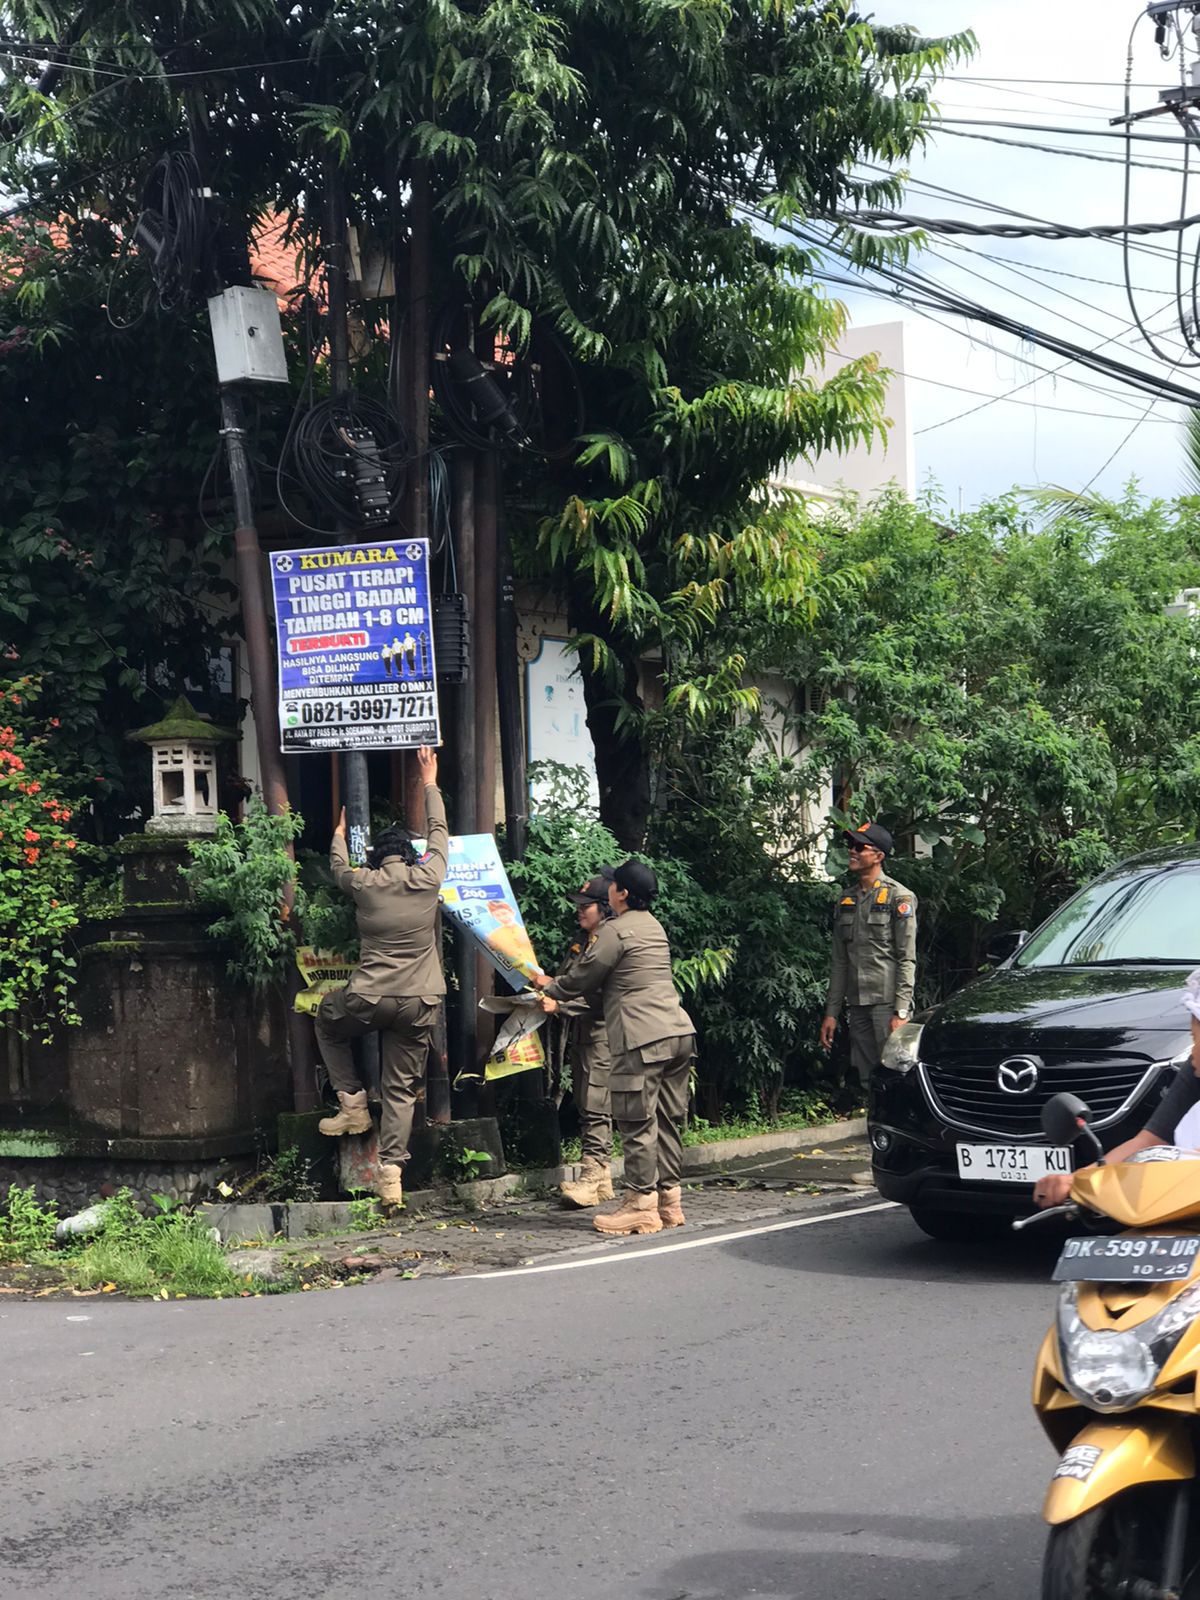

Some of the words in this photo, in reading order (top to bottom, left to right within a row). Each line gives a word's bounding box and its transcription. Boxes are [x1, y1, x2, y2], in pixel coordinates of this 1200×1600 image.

[299, 547, 400, 570] KUMARA
[288, 571, 347, 594] PUSAT
[349, 566, 414, 588] TERAPI
[288, 591, 352, 615] TINGGI
[355, 587, 417, 608] BADAN
[284, 610, 361, 635] TAMBAH
[363, 608, 392, 627] 1-8
[289, 632, 366, 652] TERBUKTI
[283, 654, 328, 668] HASILNYA
[329, 651, 380, 664] LANGSUNG
[302, 665, 322, 676] BISA
[325, 662, 361, 673] DILIHAT
[309, 673, 355, 685] DITEMPAT
[284, 685, 352, 700] MENYEMBUHKAN
[353, 684, 374, 695] KAKI
[375, 682, 399, 694] LETER
[400, 682, 408, 693] O
[409, 681, 426, 692] DAN
[426, 681, 433, 691] X
[301, 695, 434, 724] 0821-3997-7271
[317, 728, 331, 738] PASS
[306, 969, 354, 983] MEMBUA
[961, 1148, 972, 1168] B
[985, 1148, 1029, 1170] 1731
[1044, 1150, 1067, 1171] KU
[1065, 1240, 1096, 1258] DK
[1104, 1239, 1160, 1258] 5991
[1169, 1238, 1200, 1257] UR
